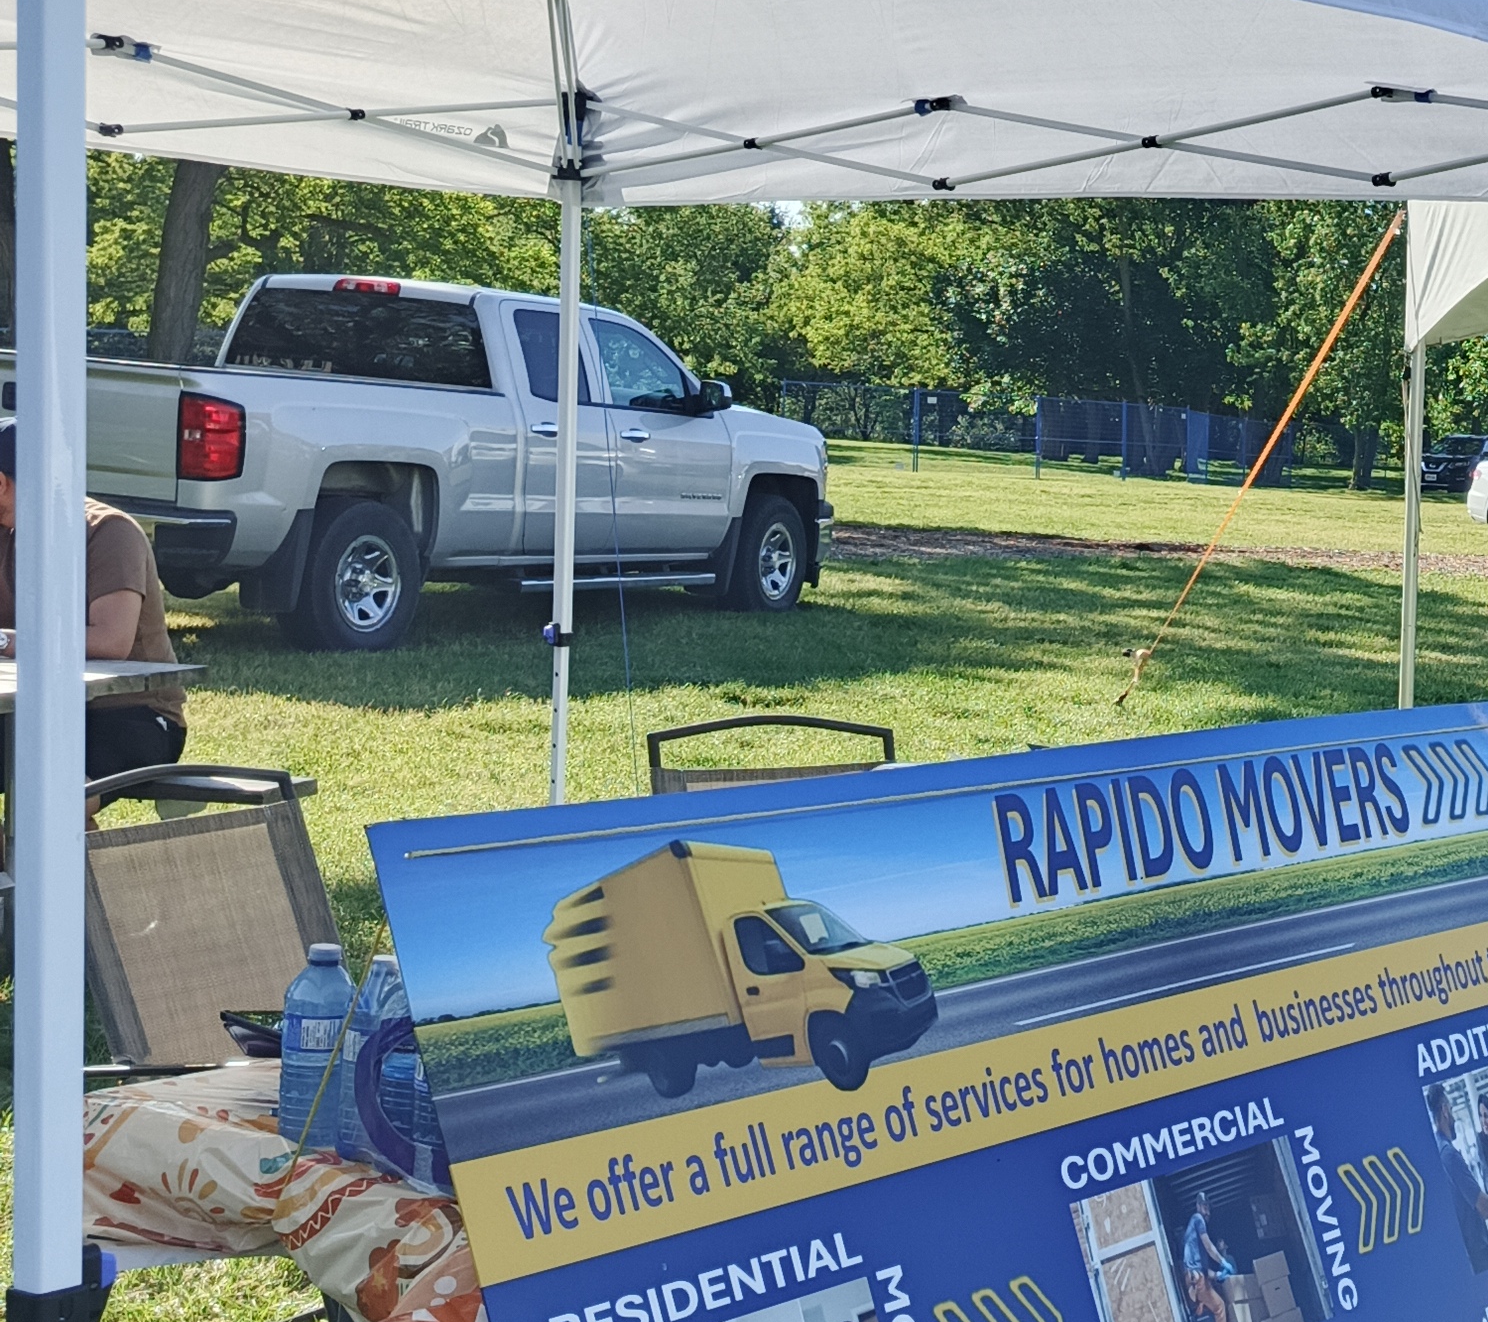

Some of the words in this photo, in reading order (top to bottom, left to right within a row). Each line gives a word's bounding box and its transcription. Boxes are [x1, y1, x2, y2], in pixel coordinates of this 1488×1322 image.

[994, 767, 1214, 908] RAPIDO
[1215, 743, 1411, 863] MOVERS
[505, 1178, 579, 1240] We
[587, 1154, 675, 1221] offer
[685, 1154, 711, 1195] a
[714, 1122, 776, 1187] full
[781, 1112, 878, 1168] range
[884, 1085, 919, 1143] of
[925, 1067, 1049, 1132] services
[1051, 1049, 1095, 1097] for
[1098, 1030, 1195, 1084] homes
[1198, 1003, 1249, 1058] and
[1252, 990, 1378, 1043] businesses
[1378, 954, 1488, 1009] throughout
[1060, 1097, 1285, 1190] COMMERCIAL
[1294, 1125, 1358, 1311] MOVING
